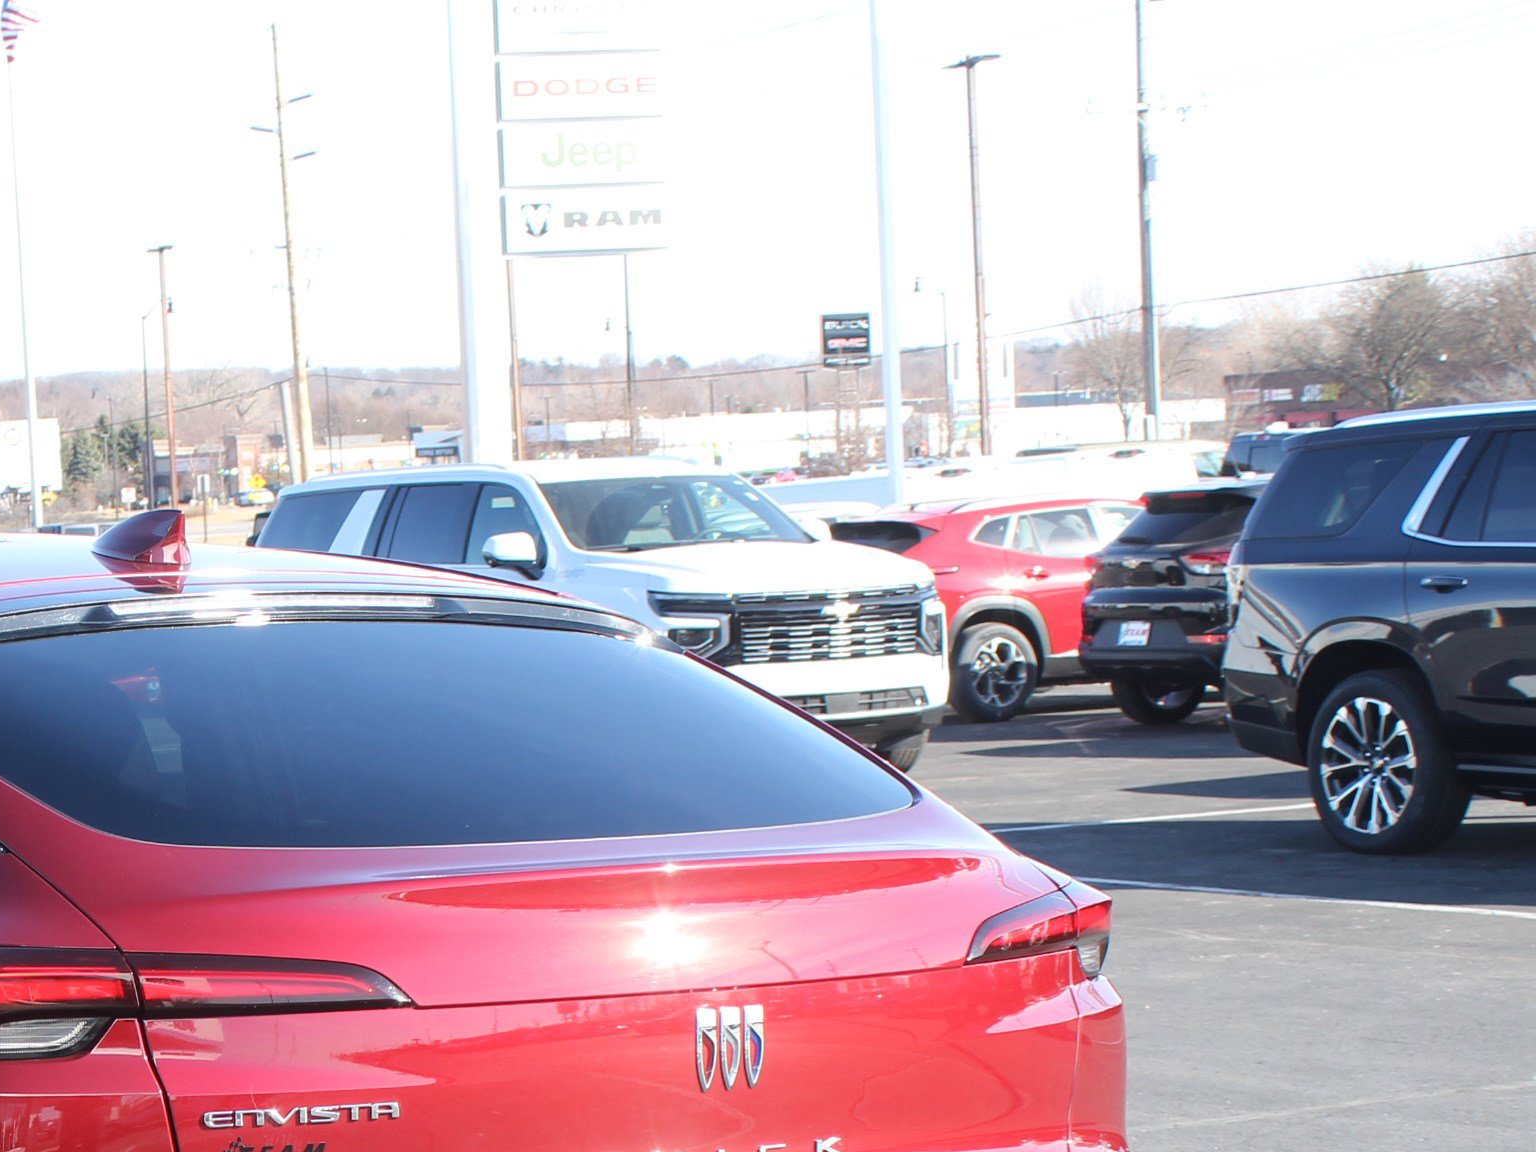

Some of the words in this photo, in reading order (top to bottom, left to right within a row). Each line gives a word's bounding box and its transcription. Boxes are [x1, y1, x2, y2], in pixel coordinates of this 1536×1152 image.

[513, 77, 657, 97] DODGE
[541, 133, 637, 173] Jeep
[563, 209, 662, 229] RAM
[203, 1101, 401, 1129] ENVISTA
